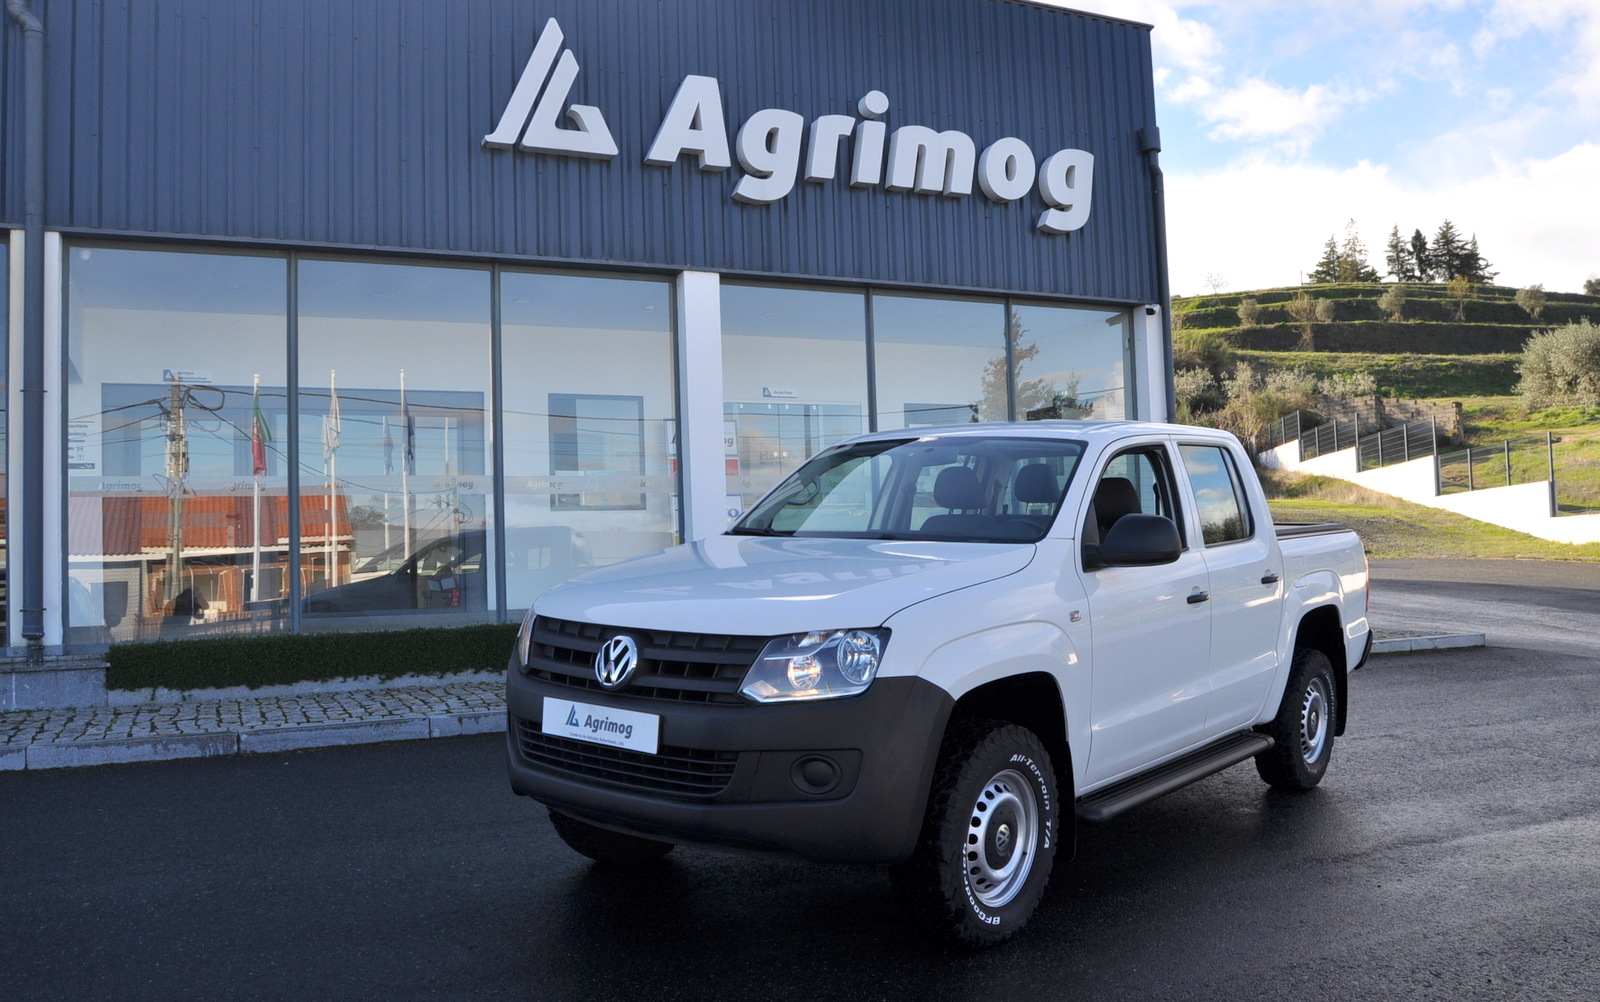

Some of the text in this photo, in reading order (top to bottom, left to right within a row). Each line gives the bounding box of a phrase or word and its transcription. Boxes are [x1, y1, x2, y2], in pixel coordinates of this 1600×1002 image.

[643, 74, 1094, 234] Agrimog
[584, 714, 633, 739] Agrimog
[1010, 753, 1050, 810] All-Terrain
